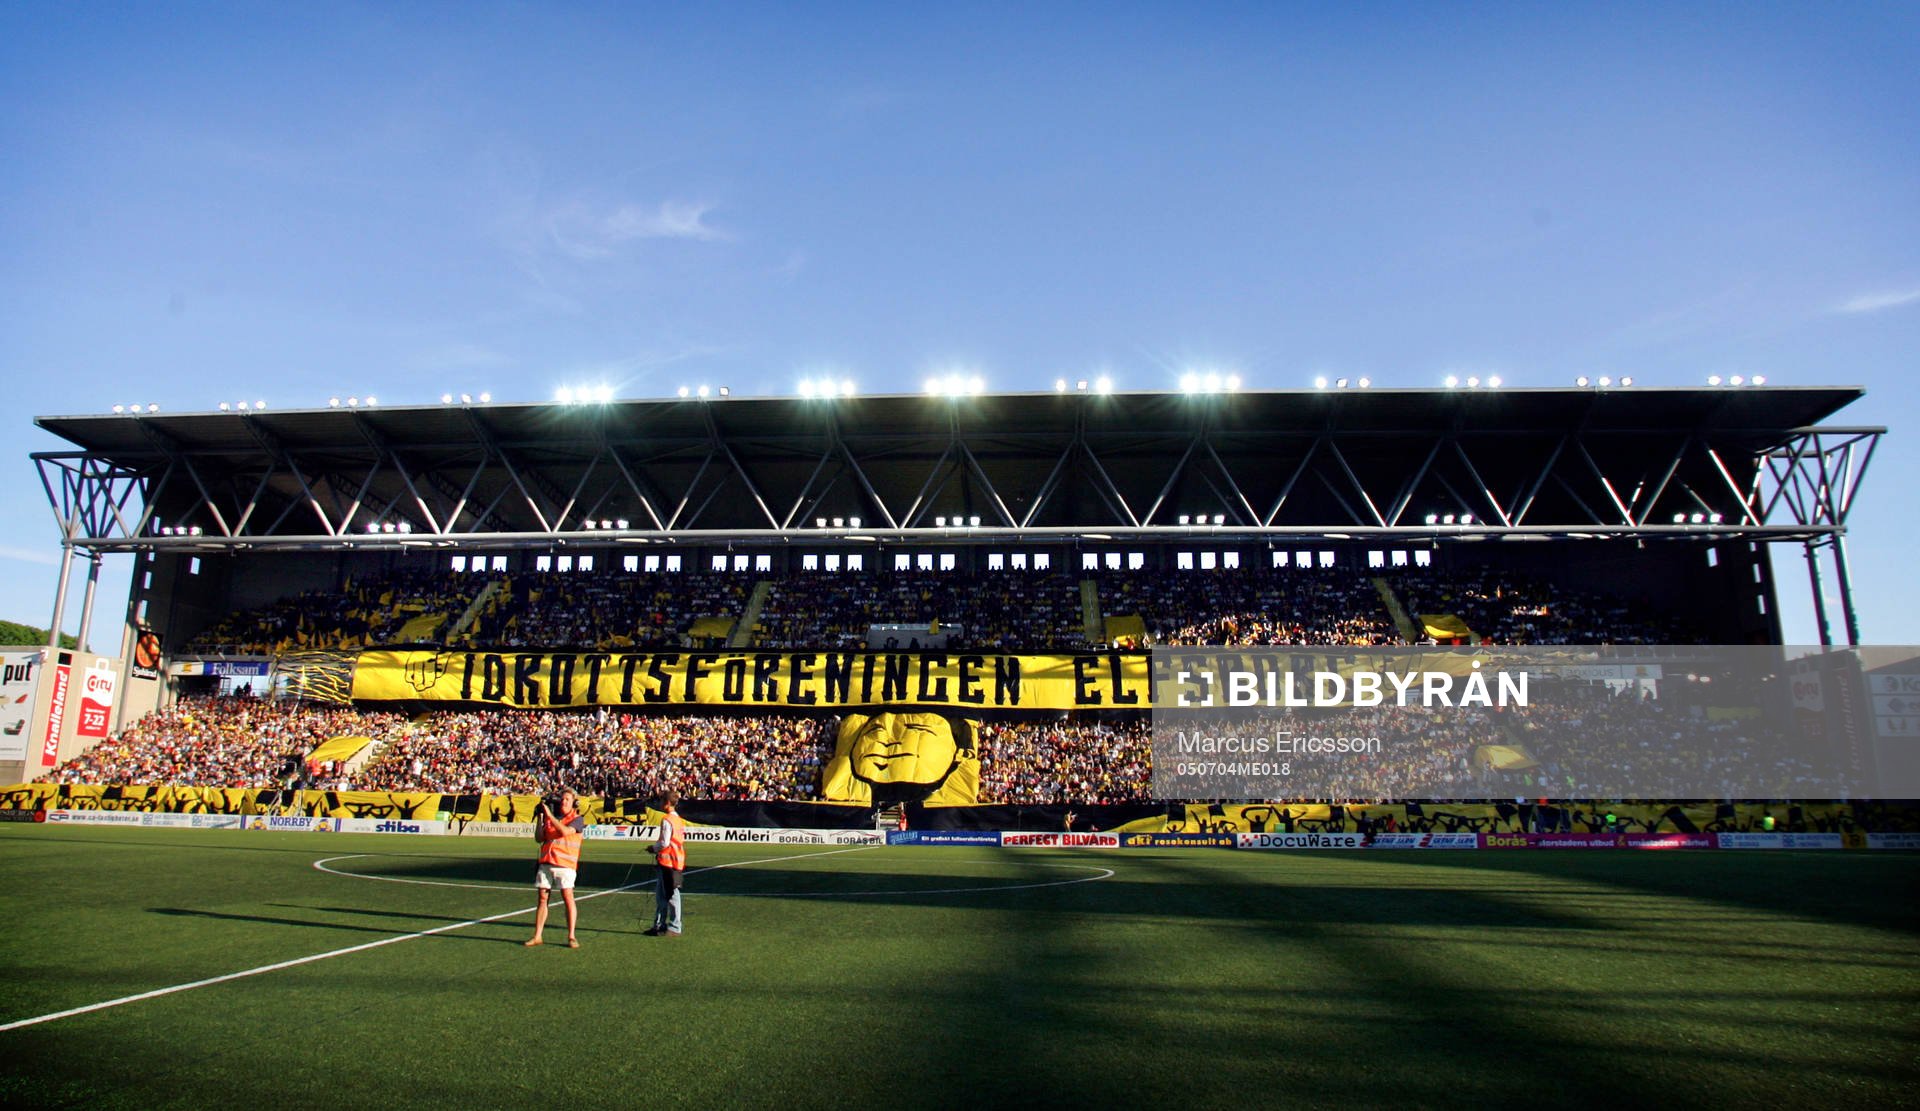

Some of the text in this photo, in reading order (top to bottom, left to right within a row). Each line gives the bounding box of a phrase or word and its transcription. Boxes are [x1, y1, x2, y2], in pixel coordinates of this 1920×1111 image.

[212, 662, 259, 675] Folksam
[461, 653, 1020, 705] IDROTTSFÖRENINGEN
[44, 670, 69, 756] Knalleland
[84, 713, 105, 726] 7-22
[269, 815, 312, 827] NORRBY
[376, 820, 420, 832] stiba
[630, 826, 657, 837] IVT
[725, 829, 770, 841] Måleri
[779, 834, 825, 844] BORÅS BIL
[837, 836, 867, 844] BORÅS
[1003, 833, 1118, 846] PERFECT BILVÅRD
[1260, 833, 1355, 848] DocuWare
[1486, 834, 1527, 847] Borås
